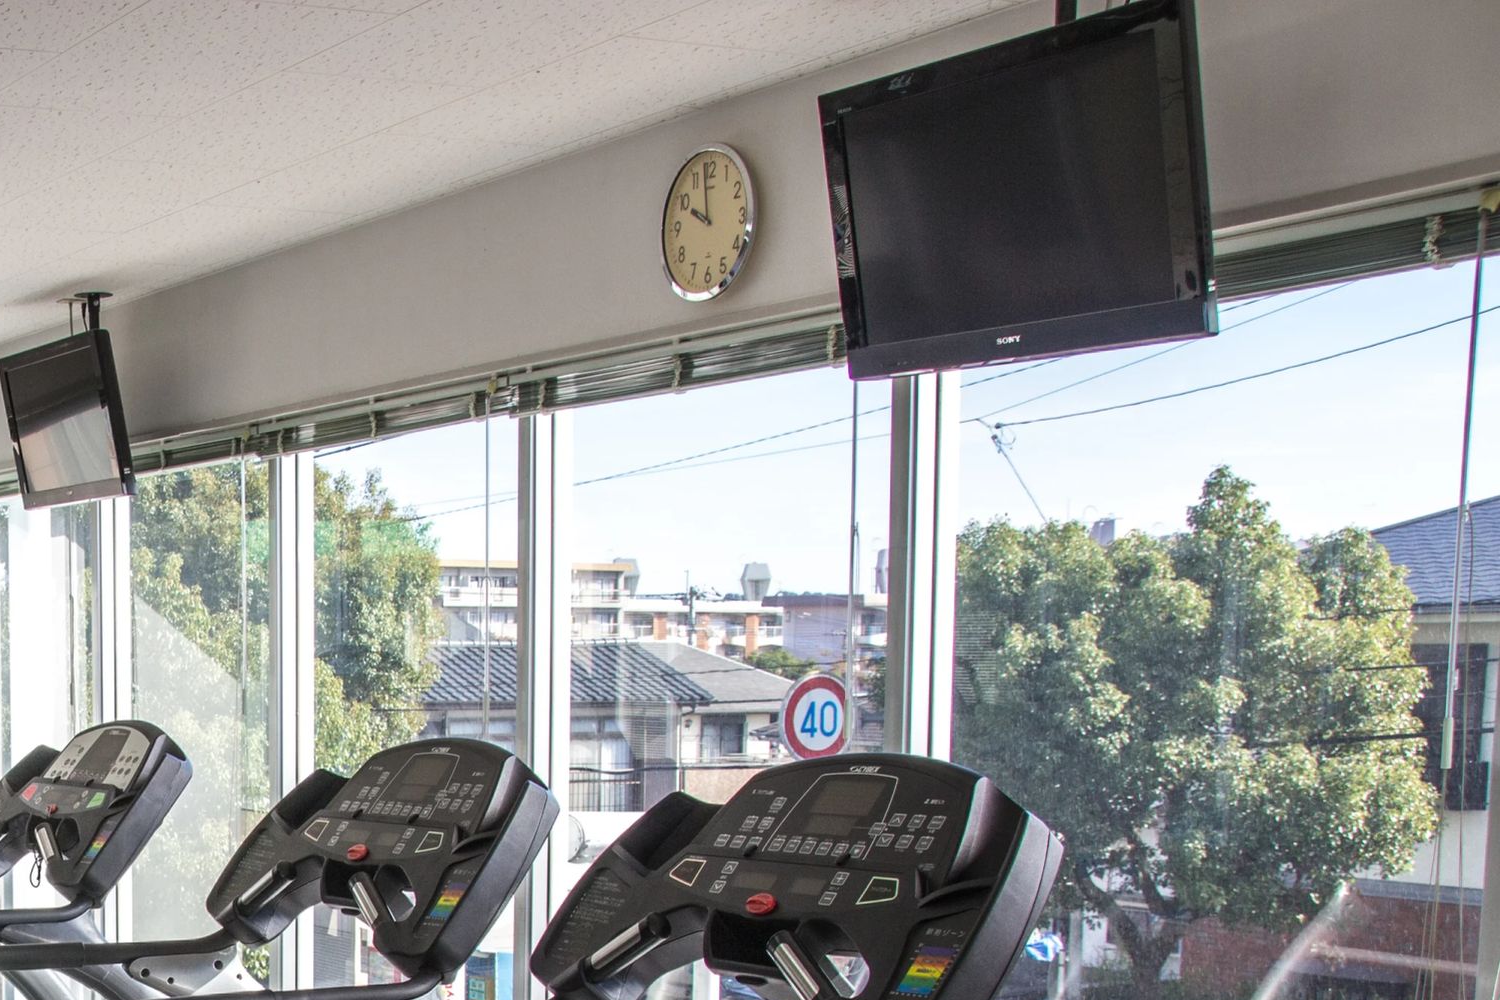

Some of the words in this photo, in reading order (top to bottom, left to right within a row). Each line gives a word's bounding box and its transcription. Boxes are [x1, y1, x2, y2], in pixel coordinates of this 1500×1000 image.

[692, 172, 699, 189] 11
[724, 165, 729, 182] 1
[734, 181, 741, 199] 2
[680, 193, 690, 211] 10
[738, 207, 746, 224] 3
[674, 221, 681, 238] 9
[732, 234, 740, 252] 4
[678, 246, 685, 263] 8
[690, 263, 697, 280] 7
[719, 257, 727, 274] 5
[704, 266, 712, 284] 6
[996, 335, 1021, 345] SONY
[801, 701, 838, 738] 40
